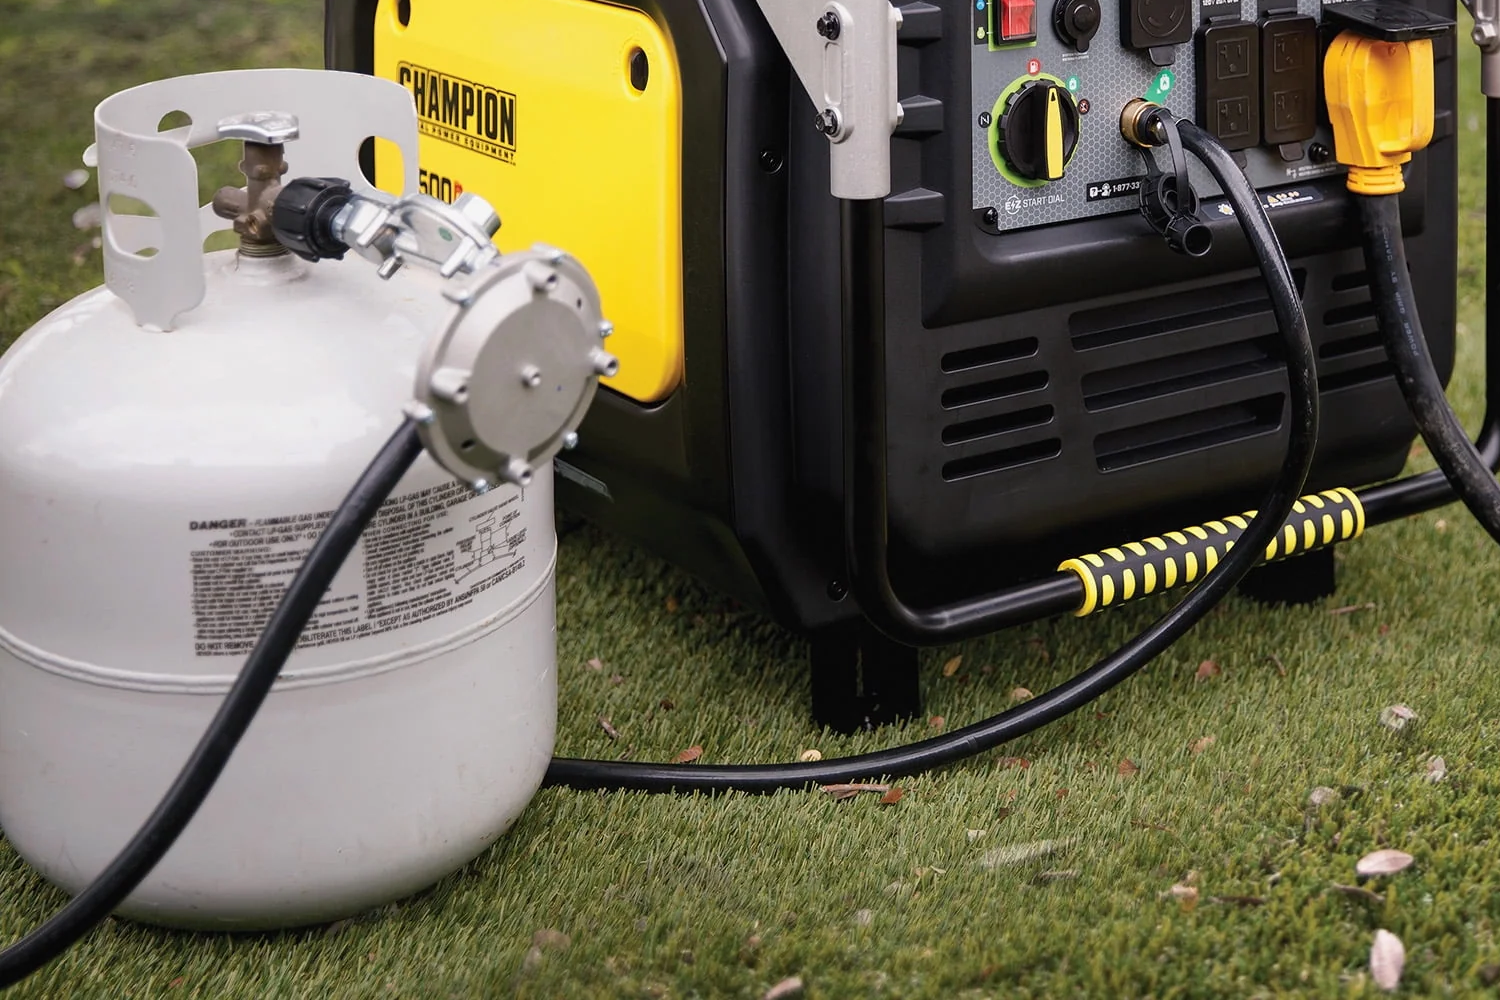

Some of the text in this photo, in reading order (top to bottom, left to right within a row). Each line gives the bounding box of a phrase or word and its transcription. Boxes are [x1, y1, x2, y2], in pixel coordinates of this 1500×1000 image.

[432, 126, 460, 142] POWER
[464, 137, 515, 161] EQUIPMENT
[419, 168, 452, 205] 500
[1112, 181, 1141, 192] 1-877-33
[1022, 196, 1047, 208] START
[1048, 194, 1065, 204] DIAL
[420, 488, 431, 497] MAY
[433, 483, 451, 494] CAUSE
[429, 489, 455, 504] CYLINDER
[378, 512, 406, 527] CYLINDER
[446, 493, 468, 507] GARAGE
[189, 518, 247, 531] DANGER
[299, 513, 313, 521] GAS
[294, 521, 326, 533] SUPPLIER
[383, 519, 421, 534] CONNECTING
[228, 537, 264, 547] OUTDOOR
[265, 535, 280, 544] USE
[338, 626, 352, 636] THIS
[353, 621, 372, 633] LABEL
[411, 600, 446, 618] AUTHORIZED
